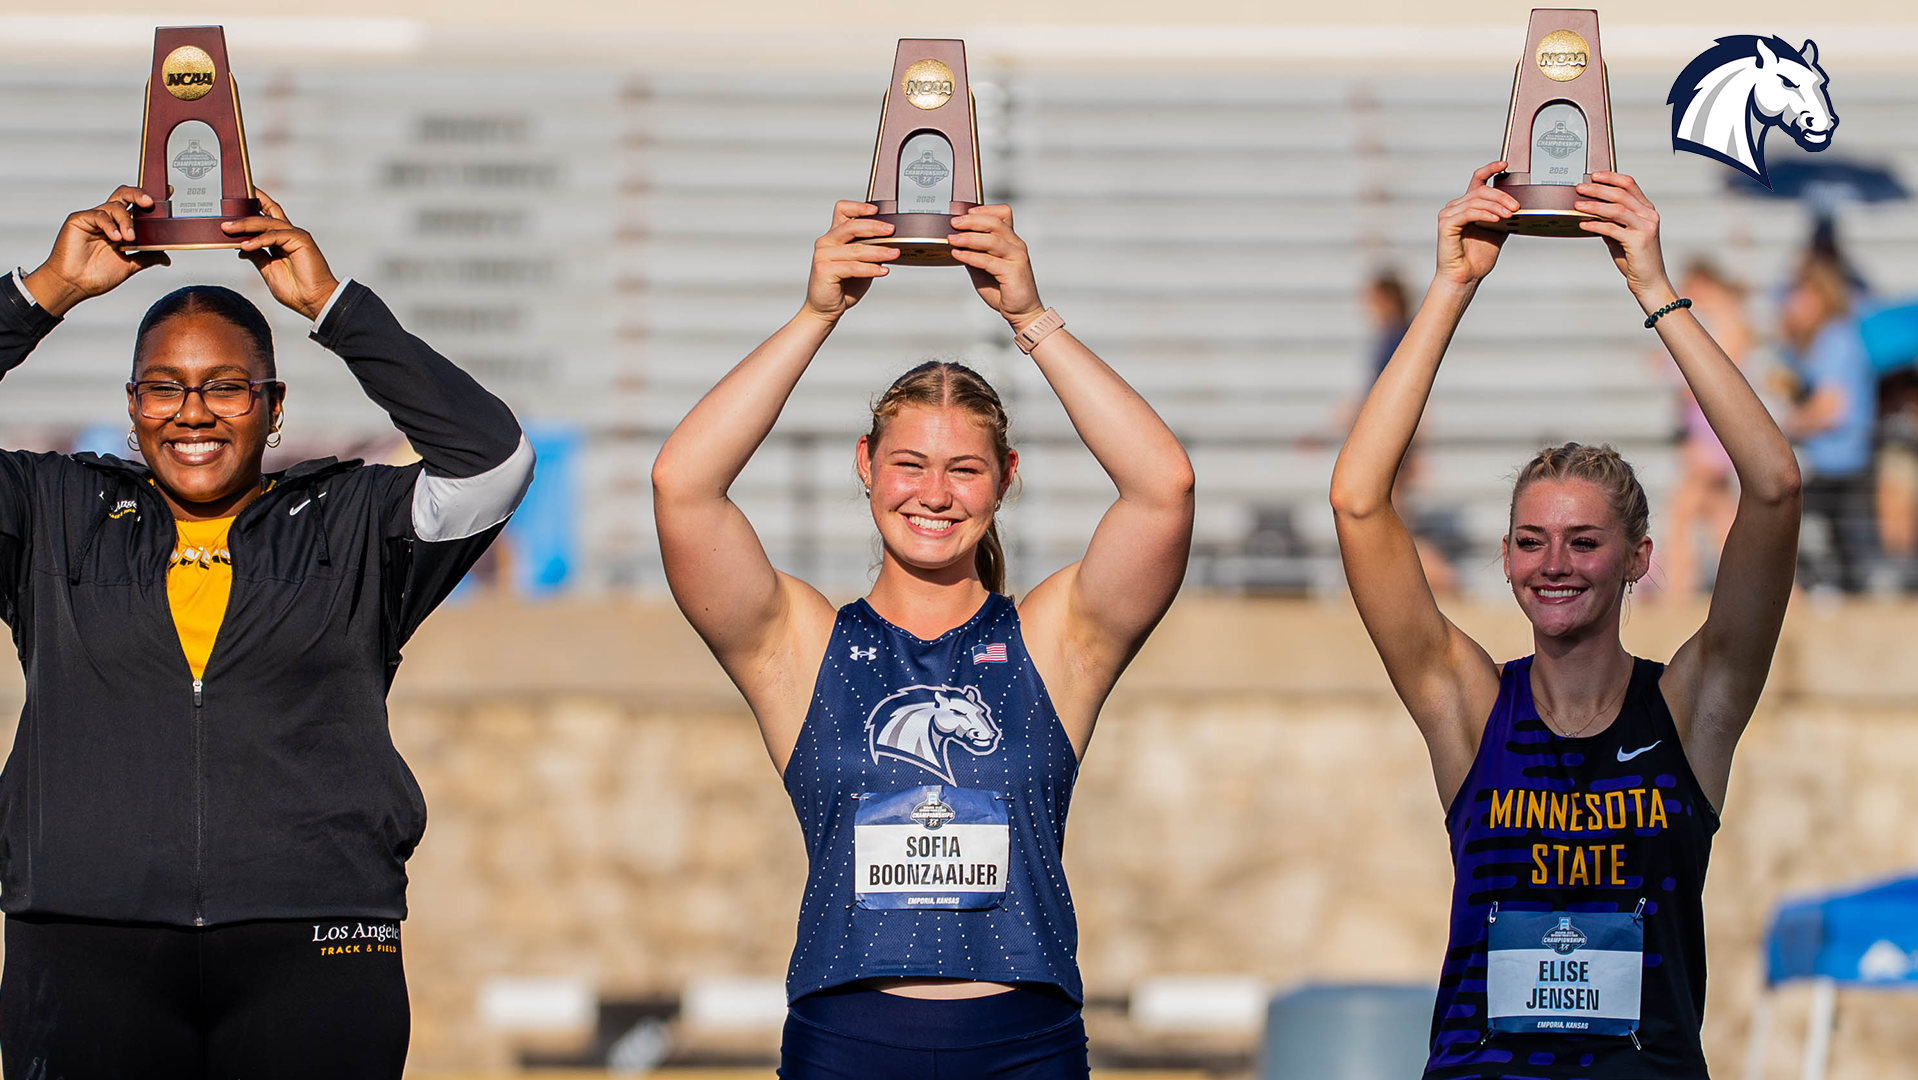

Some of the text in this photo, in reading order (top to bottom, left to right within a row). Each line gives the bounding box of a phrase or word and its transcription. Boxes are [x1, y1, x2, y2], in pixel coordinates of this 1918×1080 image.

[1540, 52, 1587, 67] NCAA
[166, 72, 213, 87] NCAA
[905, 80, 952, 96] NCAA
[1548, 166, 1570, 175] 2026
[186, 187, 207, 195] 2026
[916, 195, 936, 203] 2026
[1489, 788, 1668, 832] MINNESOTA
[906, 836, 961, 858] SOFIA
[1531, 843, 1626, 886] STATE
[869, 863, 998, 886] BOONZAAIJER
[907, 896, 960, 905] EMPORIA, KANSAS
[312, 924, 349, 943] Los
[320, 943, 397, 956] TRACK & FIELD
[1539, 960, 1589, 983] ELISE
[1526, 988, 1600, 1011] JENSEN
[1536, 1021, 1590, 1030] EMPORIA, KANSAS
